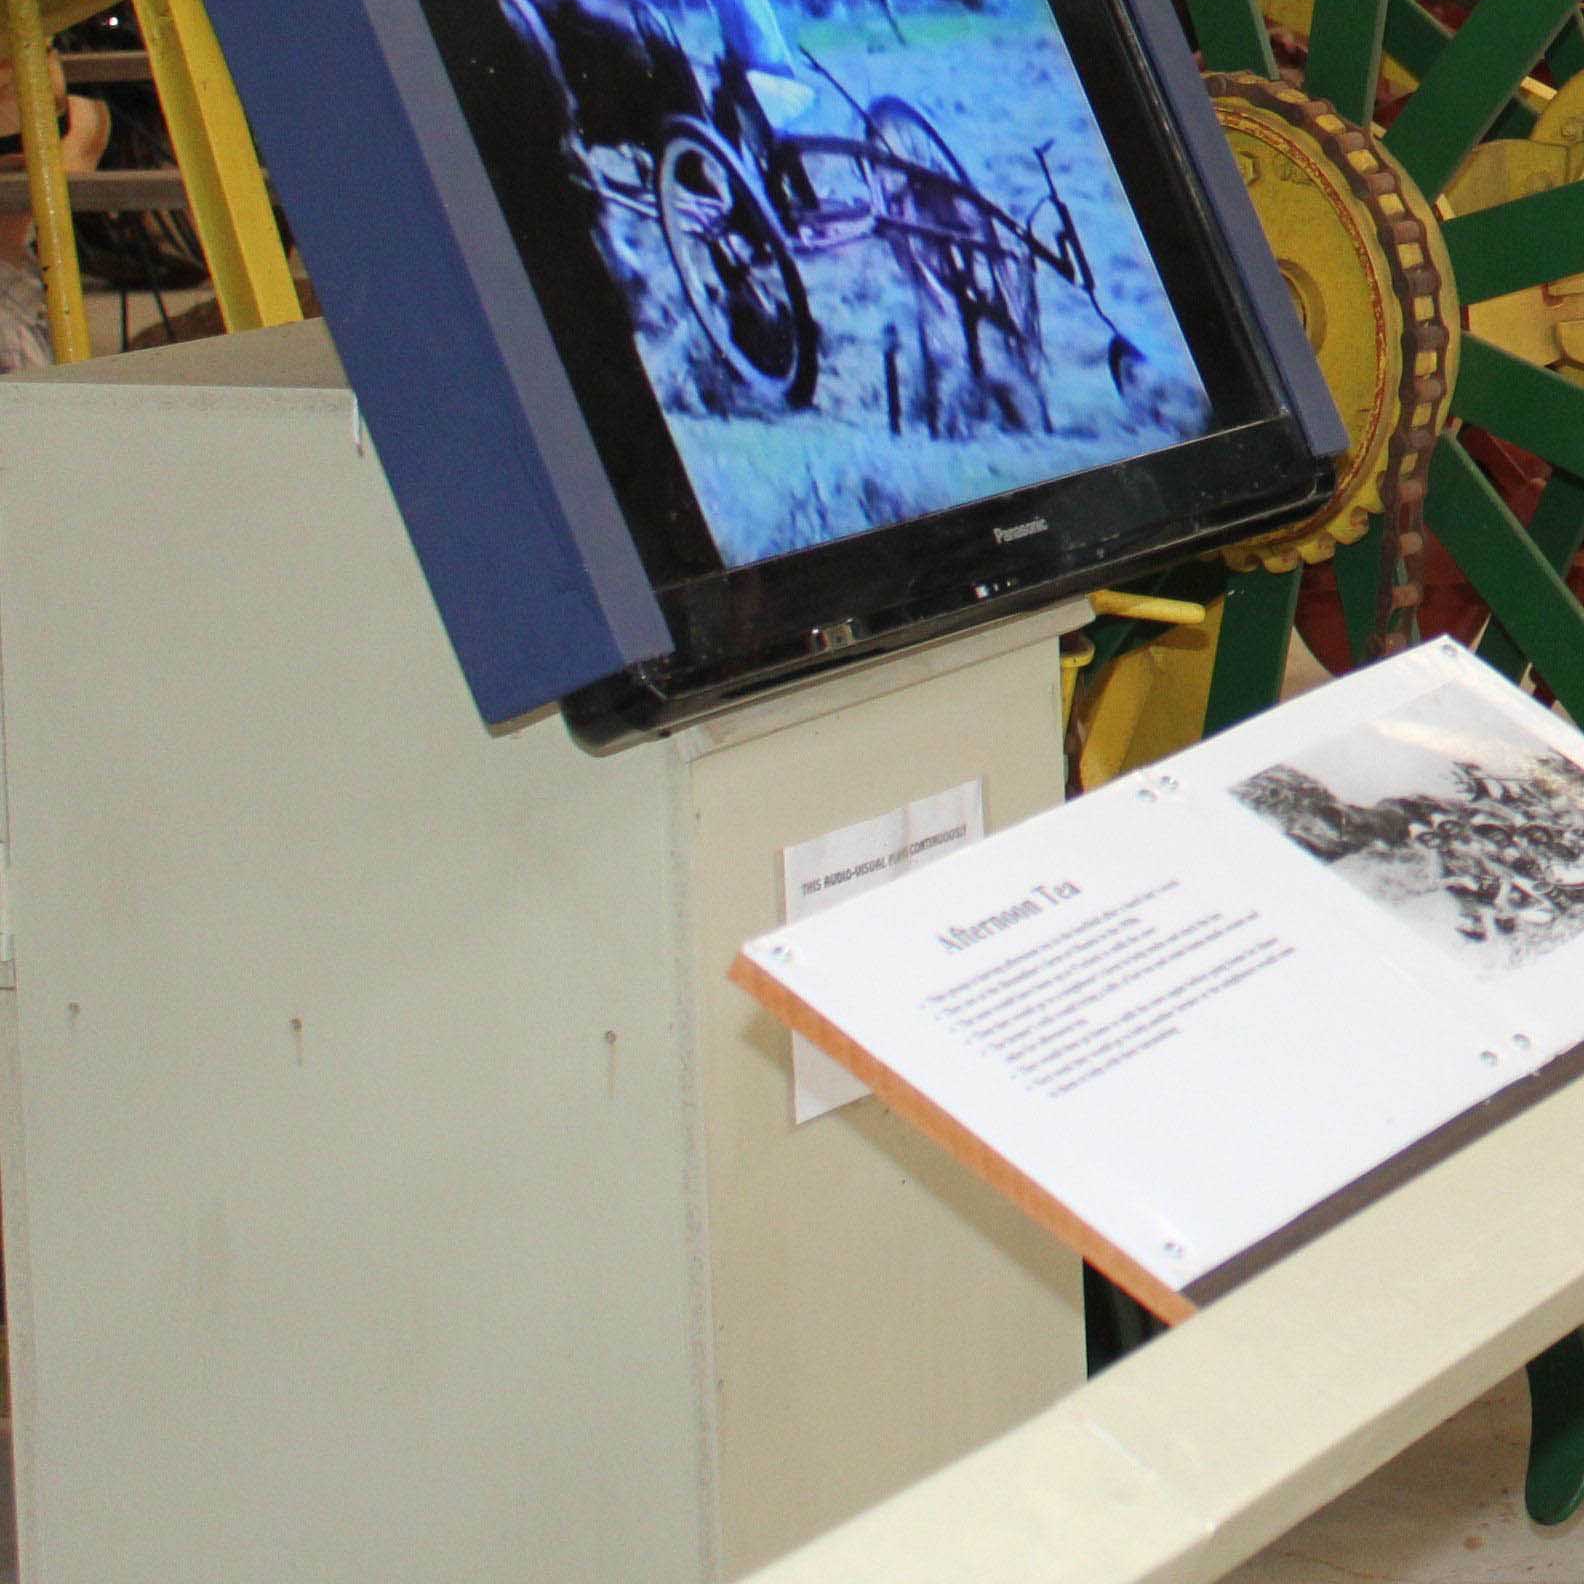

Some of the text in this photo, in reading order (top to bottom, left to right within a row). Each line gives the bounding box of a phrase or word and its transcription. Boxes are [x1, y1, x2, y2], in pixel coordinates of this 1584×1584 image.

[993, 517, 1048, 544] Panasonic
[802, 879, 822, 896] THIS
[824, 857, 886, 889] AUDIO-VISUAL
[936, 880, 1082, 952] Afternoon Tea
